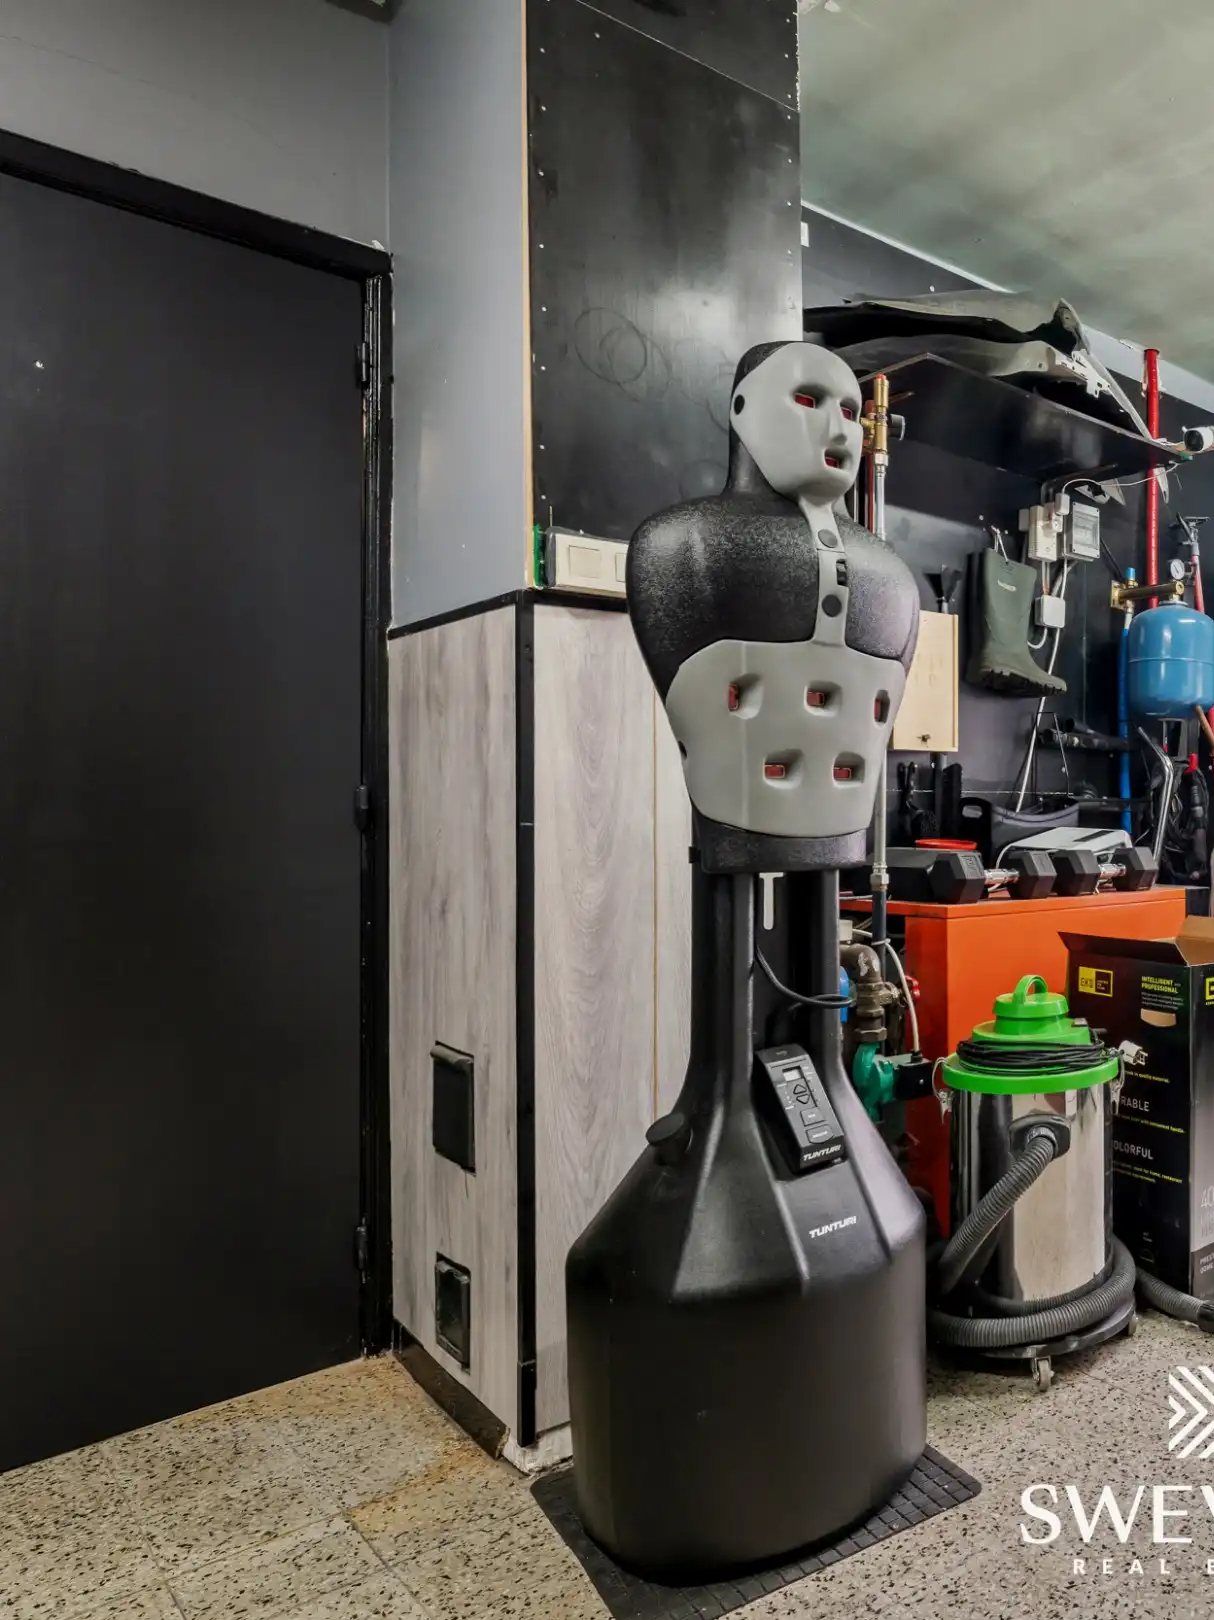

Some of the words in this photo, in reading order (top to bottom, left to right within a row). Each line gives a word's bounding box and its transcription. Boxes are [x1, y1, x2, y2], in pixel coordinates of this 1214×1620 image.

[1141, 975, 1173, 986] INTELLIGENT
[1120, 1096, 1150, 1112] RABLE
[803, 1144, 841, 1161] TUNTURI
[1113, 1140, 1154, 1160] OLORFUL
[809, 1216, 857, 1238] TUNTURI
